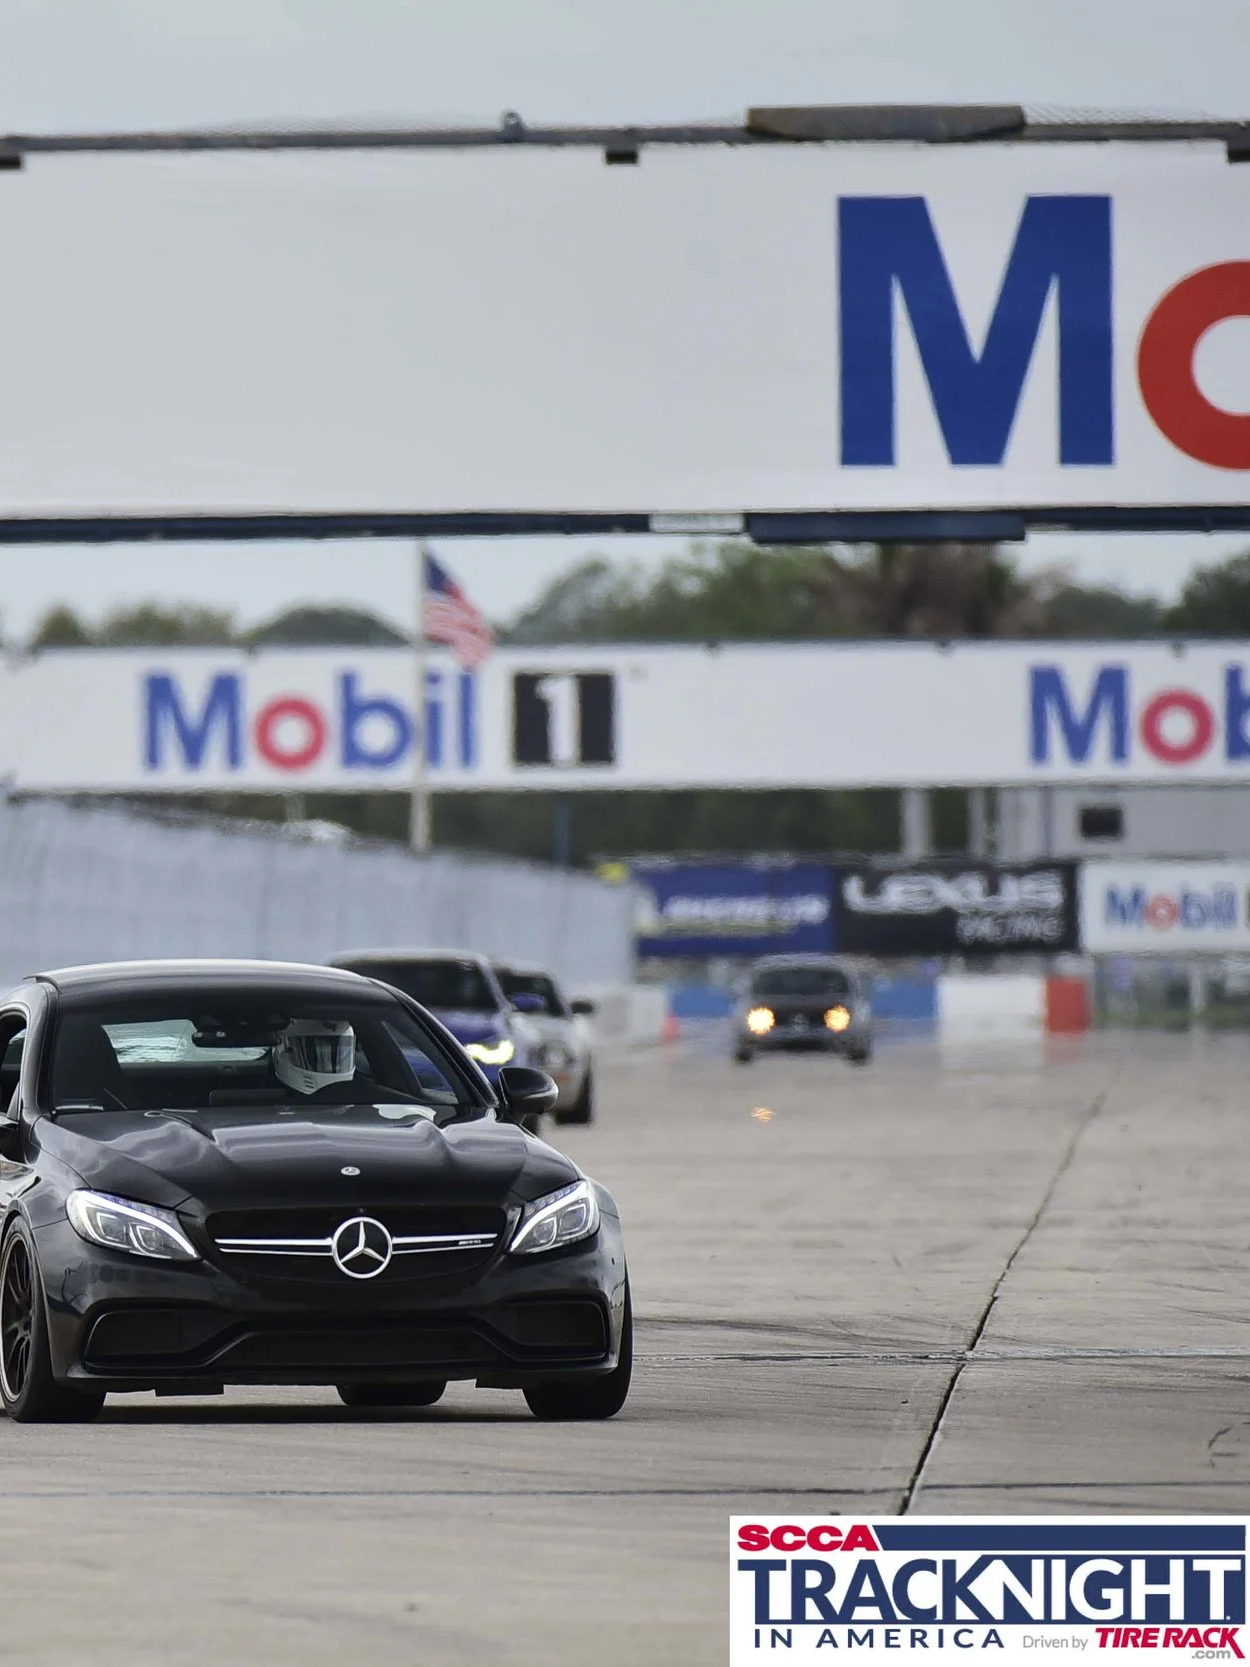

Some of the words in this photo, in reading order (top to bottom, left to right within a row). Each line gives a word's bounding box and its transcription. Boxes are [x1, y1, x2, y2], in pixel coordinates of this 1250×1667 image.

[143, 671, 478, 774] Mobil
[535, 674, 581, 767] 1
[1105, 881, 1238, 932] Mobil
